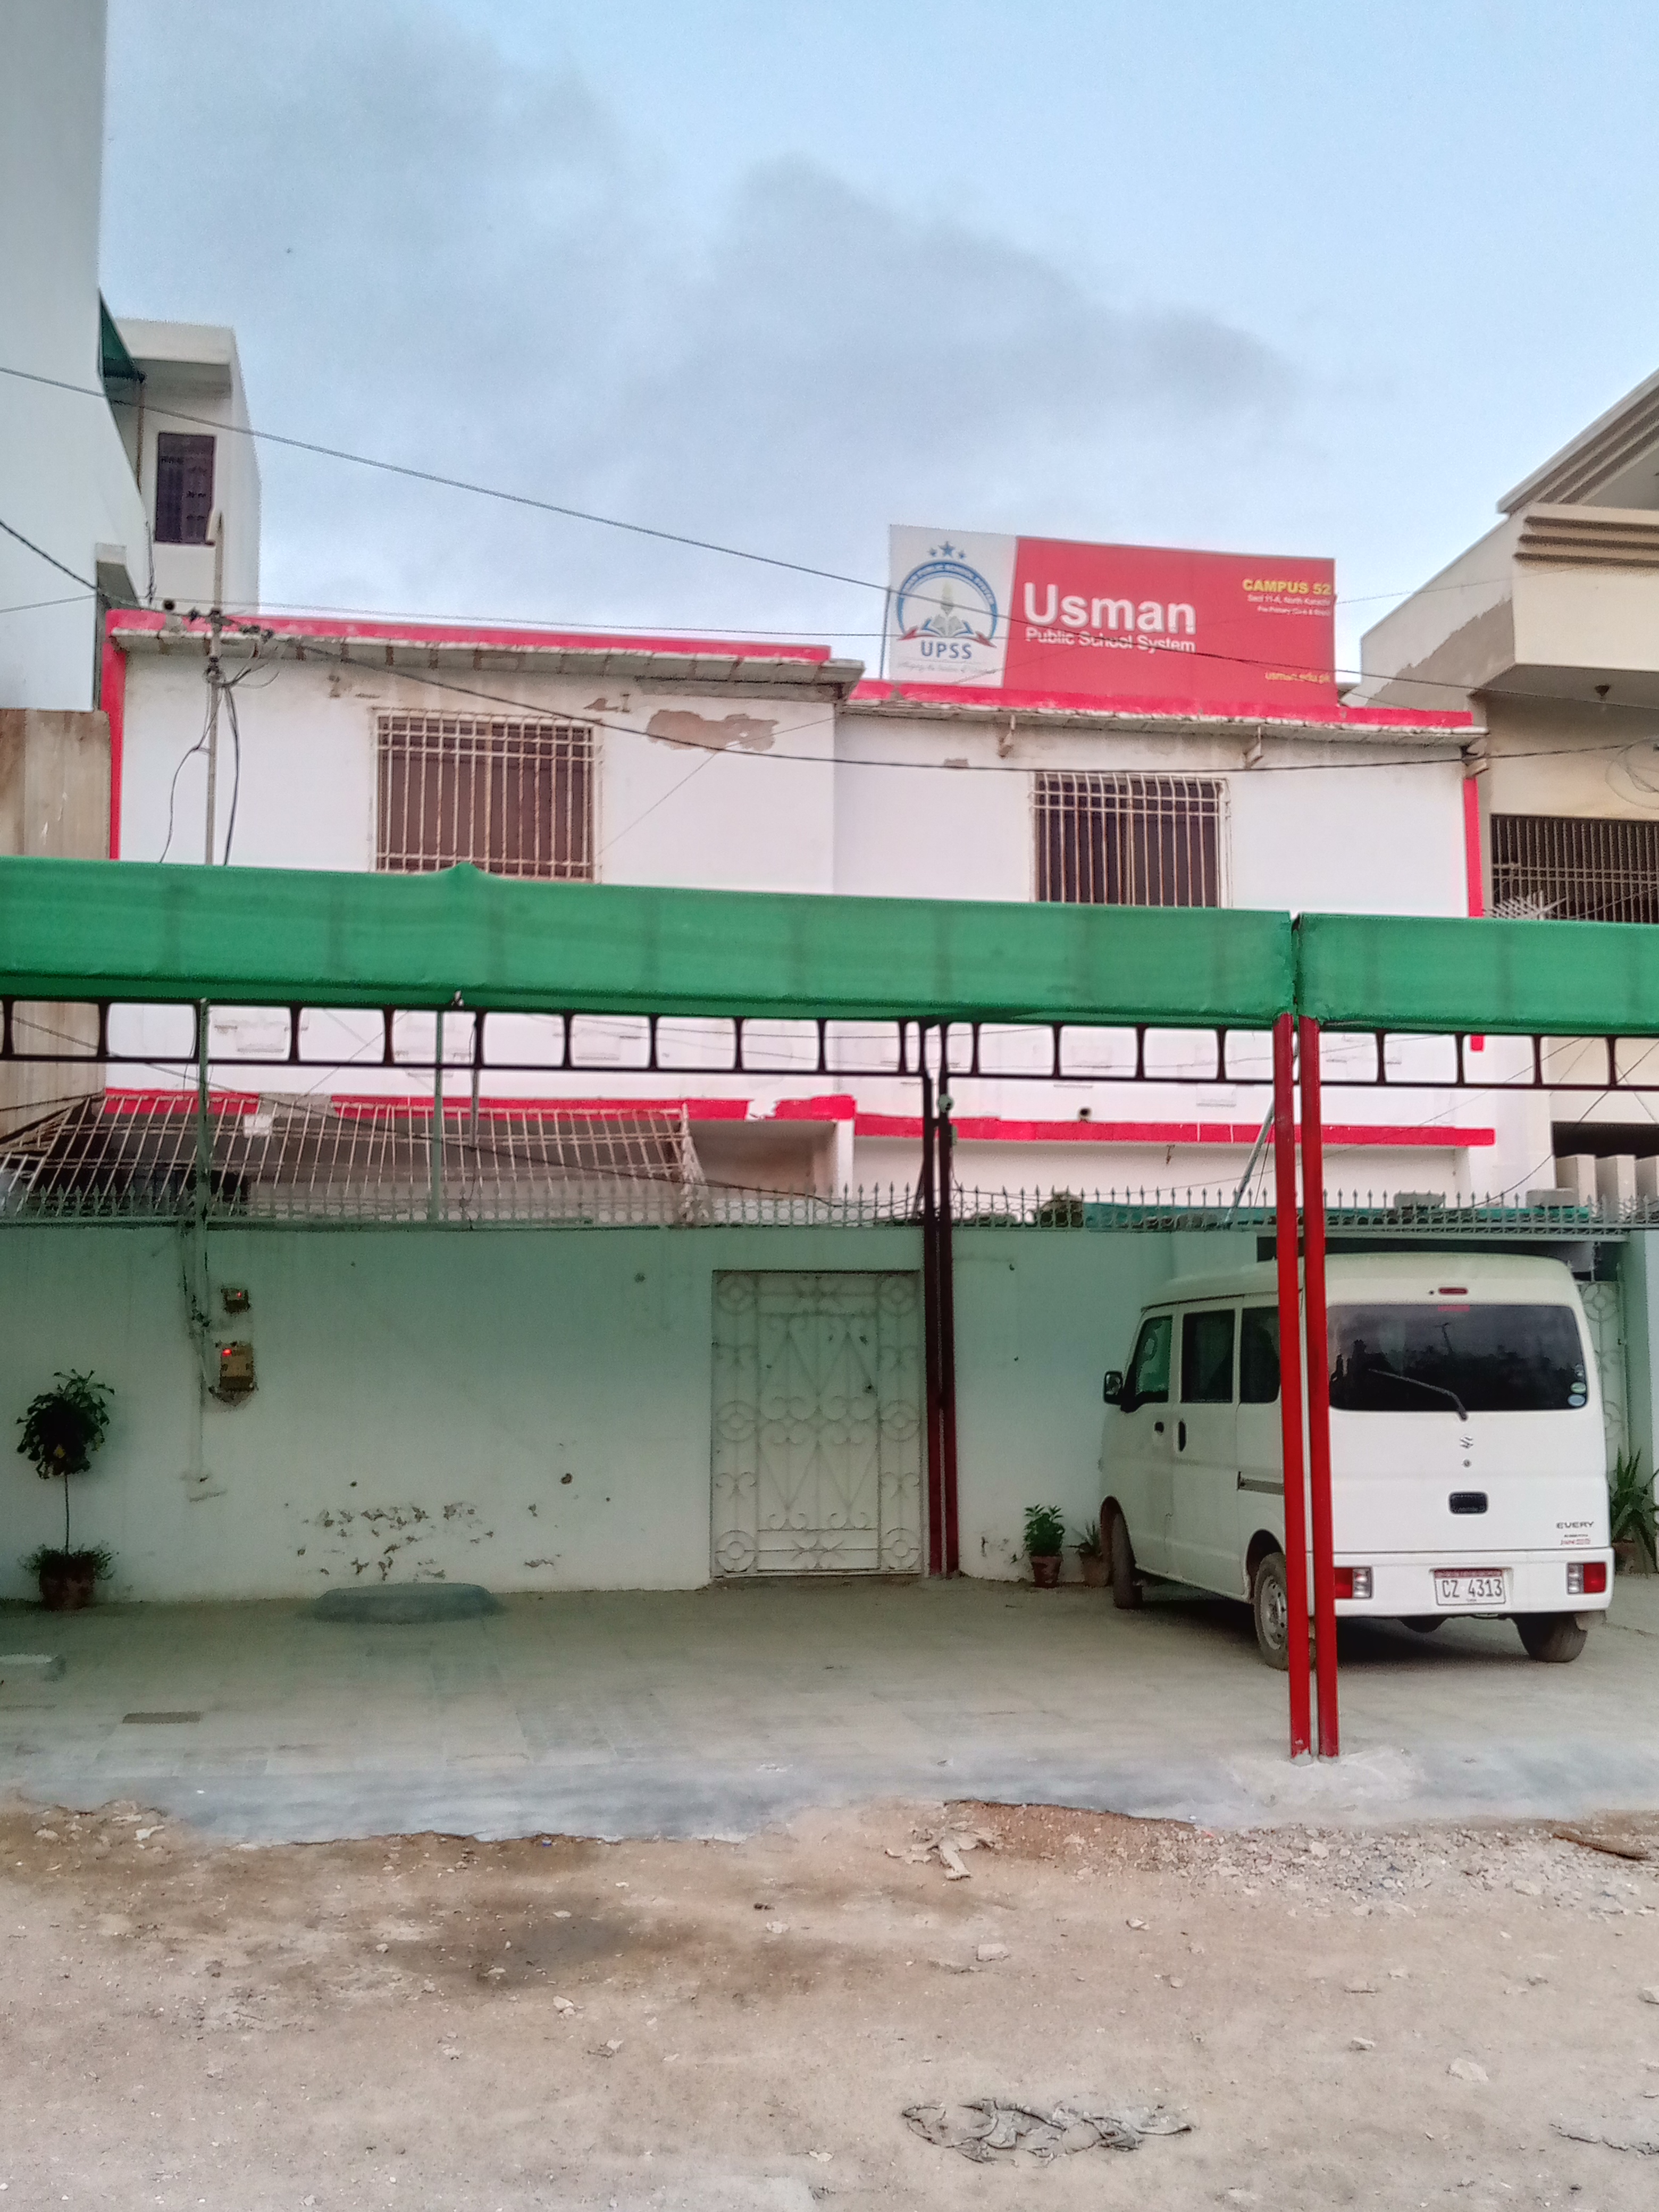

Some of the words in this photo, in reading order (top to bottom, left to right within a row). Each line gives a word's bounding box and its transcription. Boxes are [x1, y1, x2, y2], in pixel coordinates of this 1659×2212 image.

[1242, 579, 1310, 594] CAMPUS
[1312, 583, 1331, 596] 52
[1024, 582, 1196, 635] Usman
[921, 640, 972, 659] UPSS
[1026, 626, 1075, 645] Public
[1078, 631, 1133, 649] School
[1136, 634, 1196, 654] System
[1442, 1580, 1460, 1597] CZ
[1468, 1579, 1503, 1597] 4313
